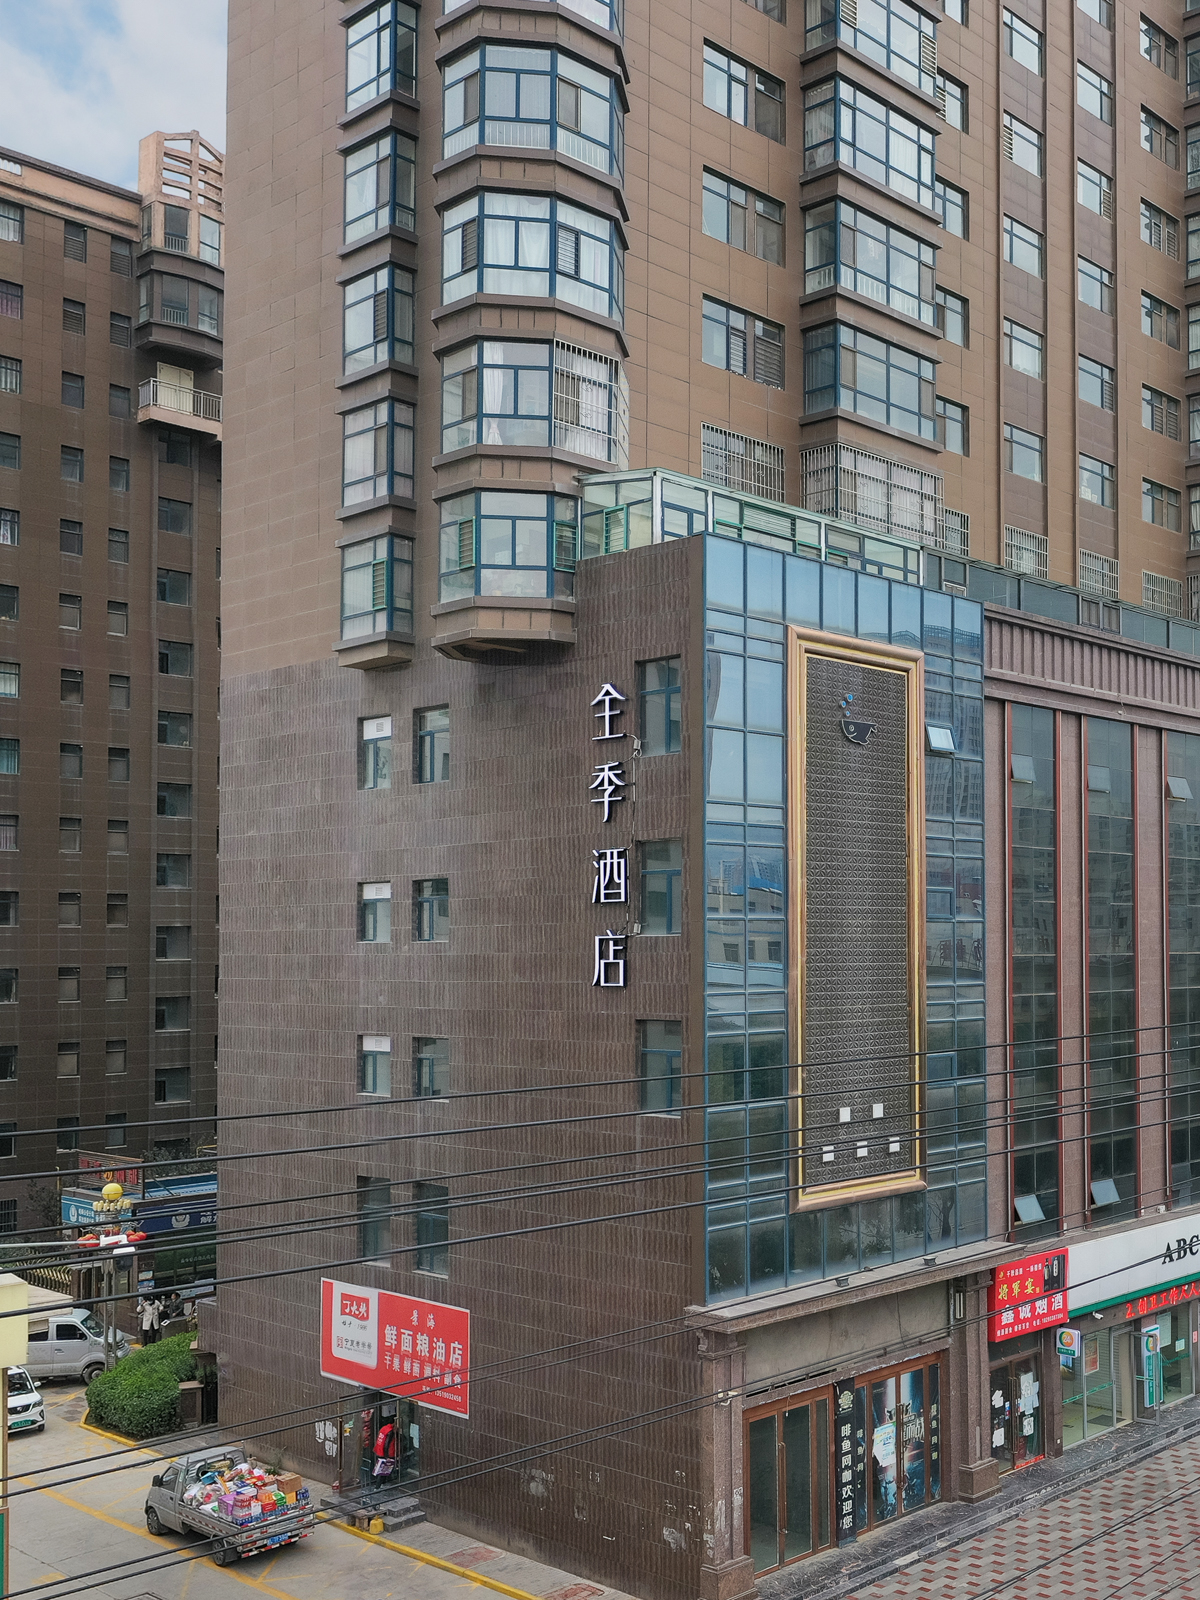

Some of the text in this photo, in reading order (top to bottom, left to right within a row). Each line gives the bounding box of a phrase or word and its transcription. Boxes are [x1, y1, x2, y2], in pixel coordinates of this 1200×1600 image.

[589, 683, 628, 988] 全季酒店
[1161, 1234, 1200, 1265] ABC
[384, 1324, 463, 1367] 鲜面粮油店
